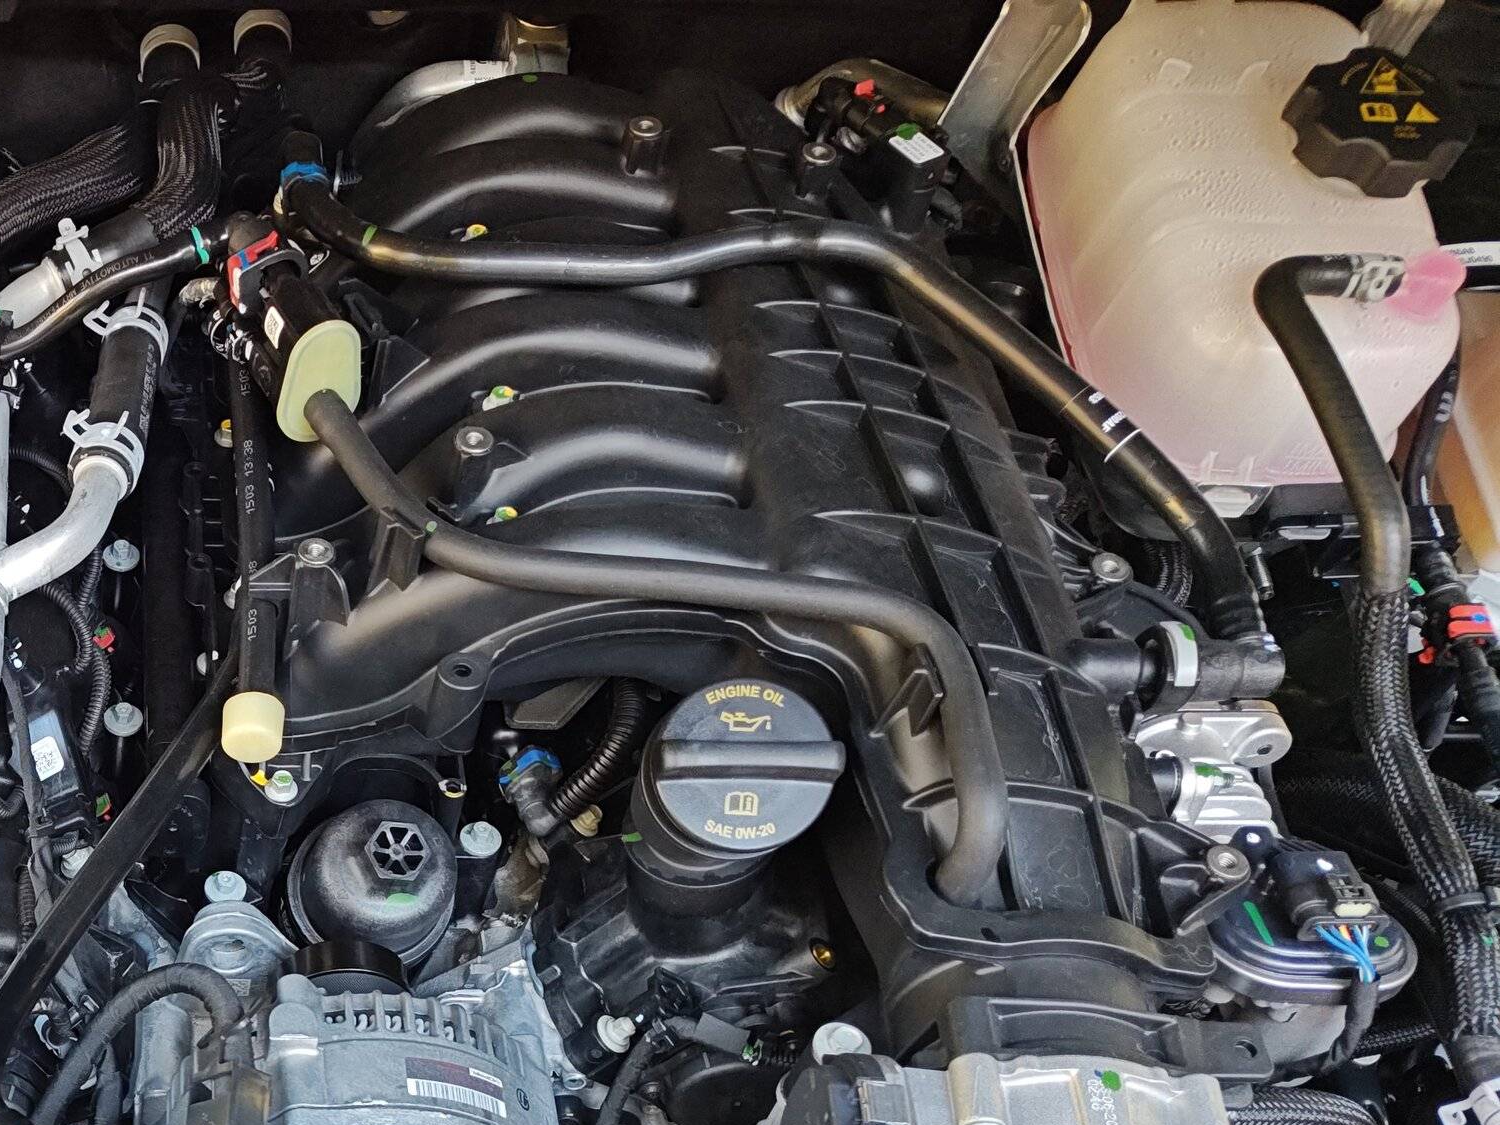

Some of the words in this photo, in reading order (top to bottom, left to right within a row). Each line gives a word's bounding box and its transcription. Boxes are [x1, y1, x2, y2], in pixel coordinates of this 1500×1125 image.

[80, 255, 140, 292] AUTOMOTIVE
[245, 484, 256, 515] 1503
[247, 608, 258, 643] 1503
[705, 685, 761, 705] ENGINE
[763, 688, 785, 708] OIL
[704, 820, 733, 839] SAE
[735, 822, 776, 840] 0W-20
